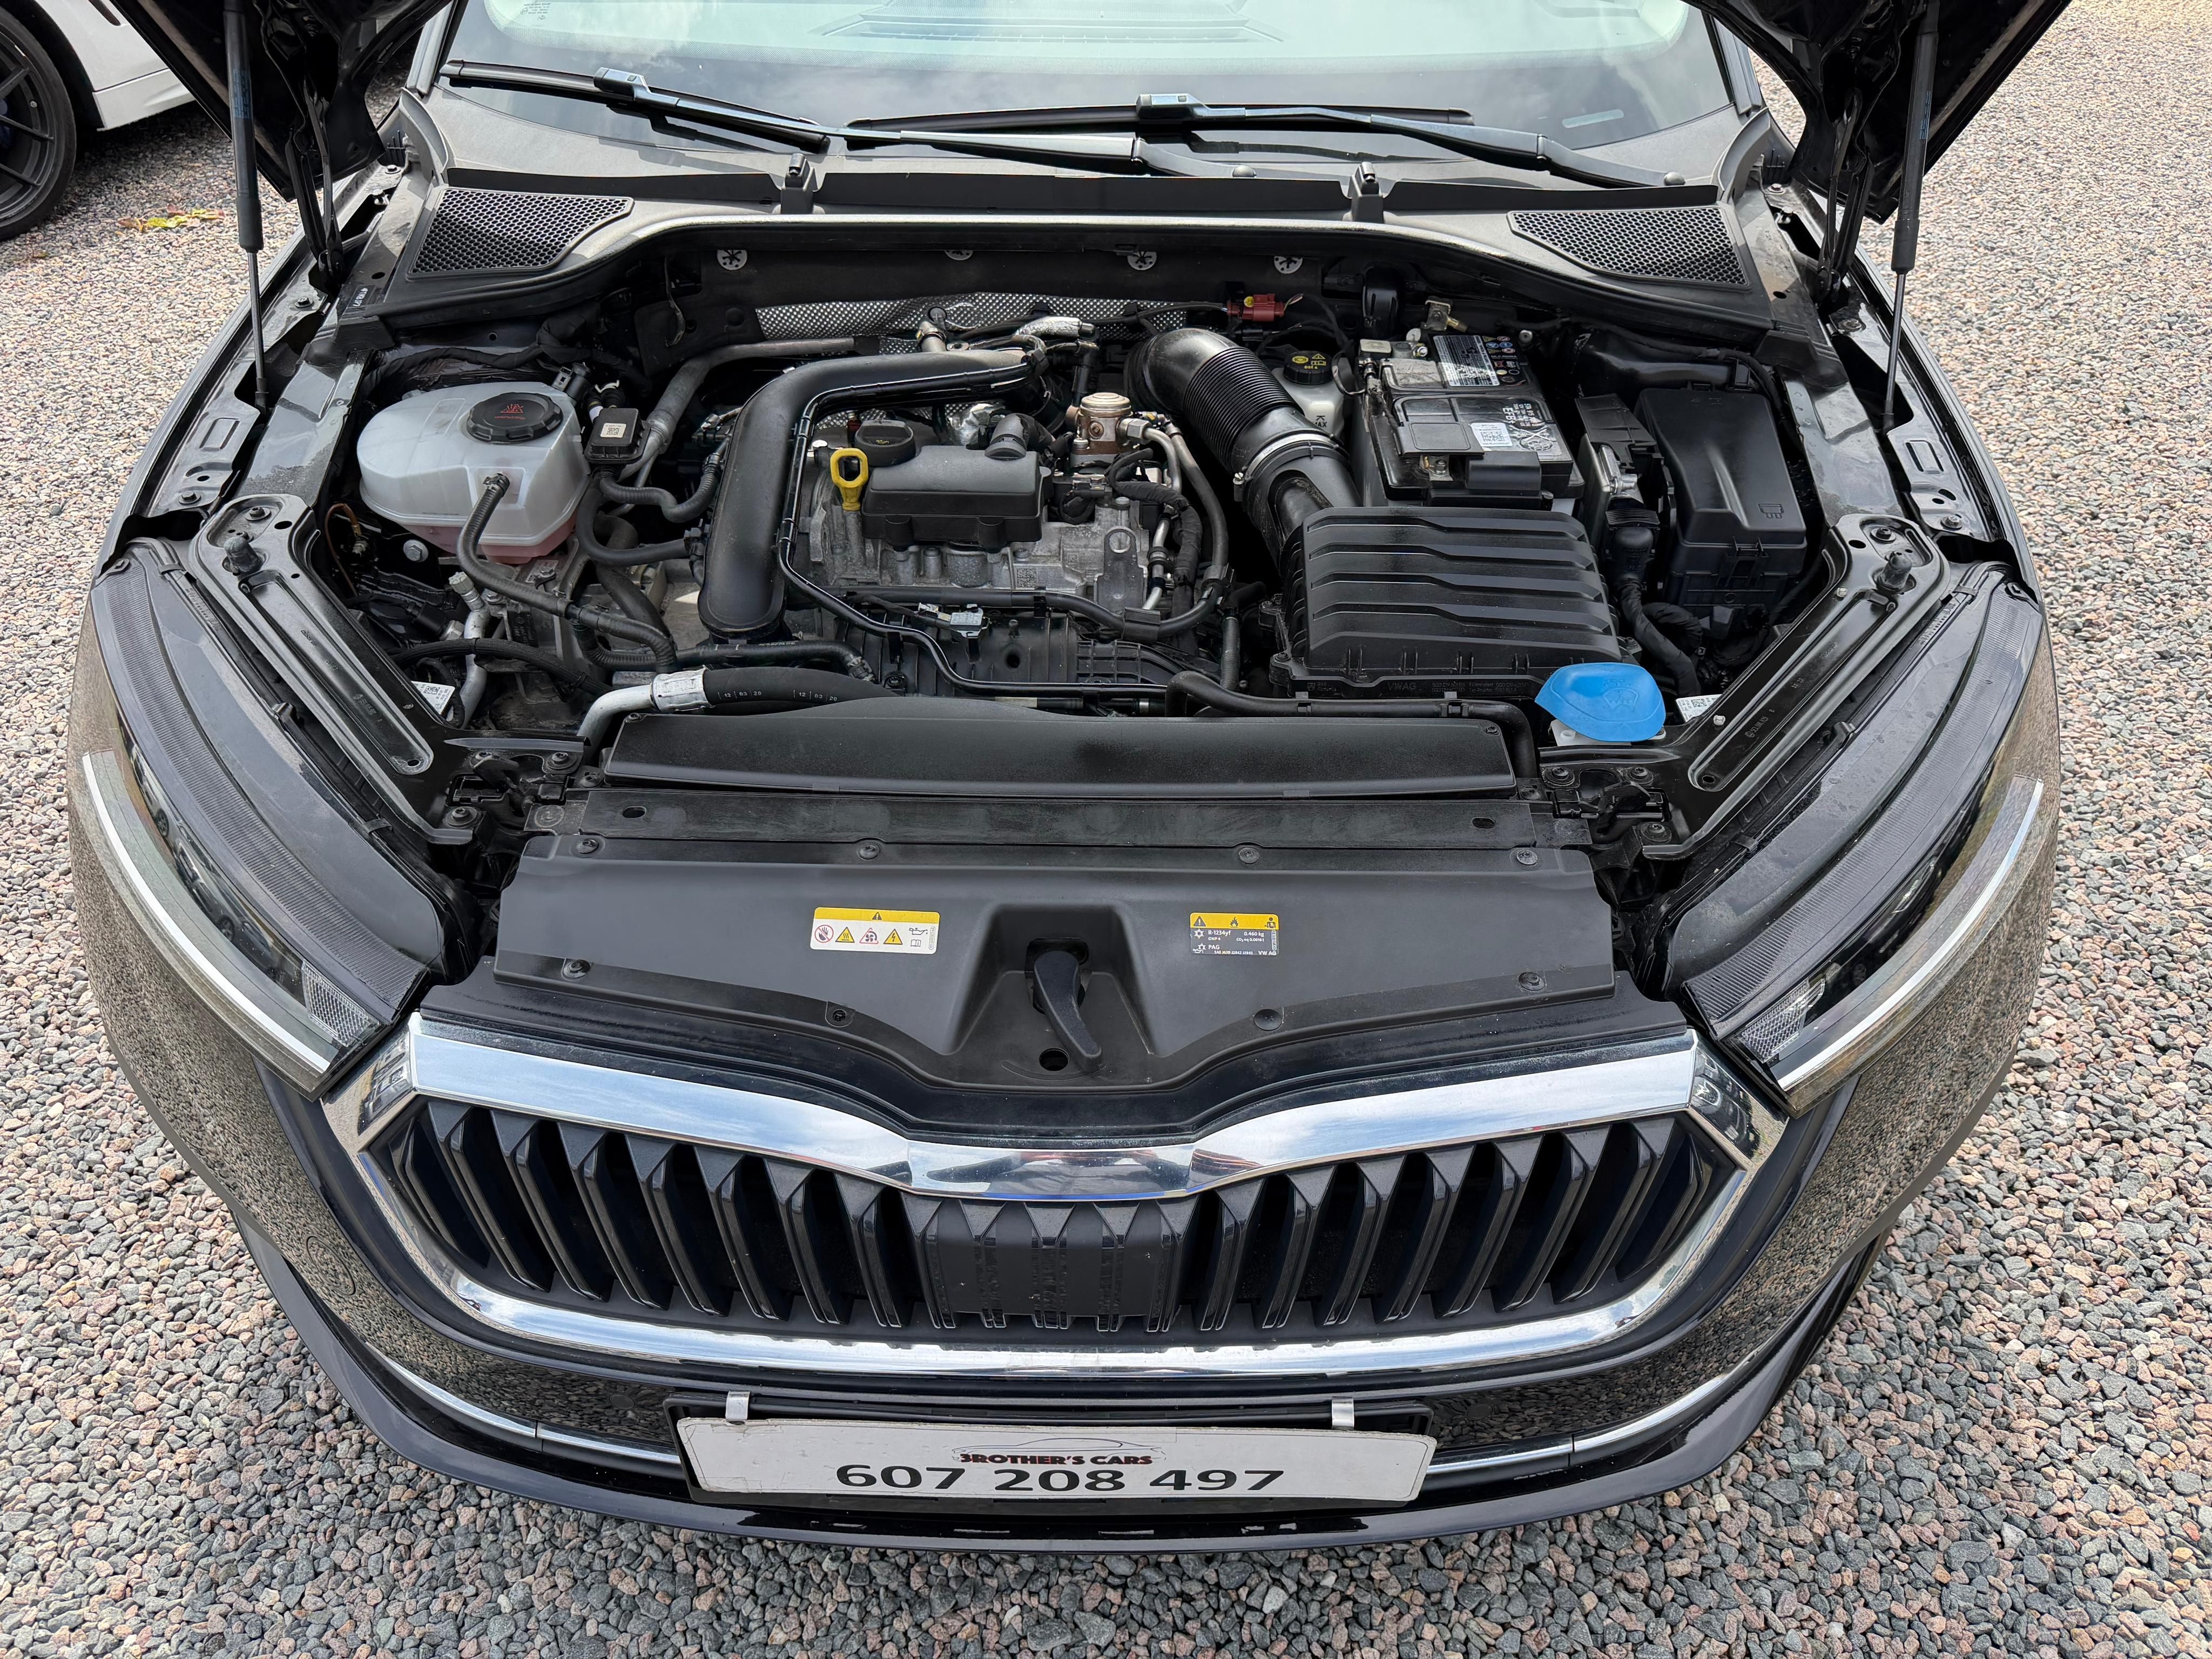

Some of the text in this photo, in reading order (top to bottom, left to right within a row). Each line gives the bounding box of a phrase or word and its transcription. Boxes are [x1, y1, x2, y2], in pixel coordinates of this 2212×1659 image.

[1090, 1455, 1153, 1465] CARS
[836, 1464, 1285, 1492] 607 208 497
